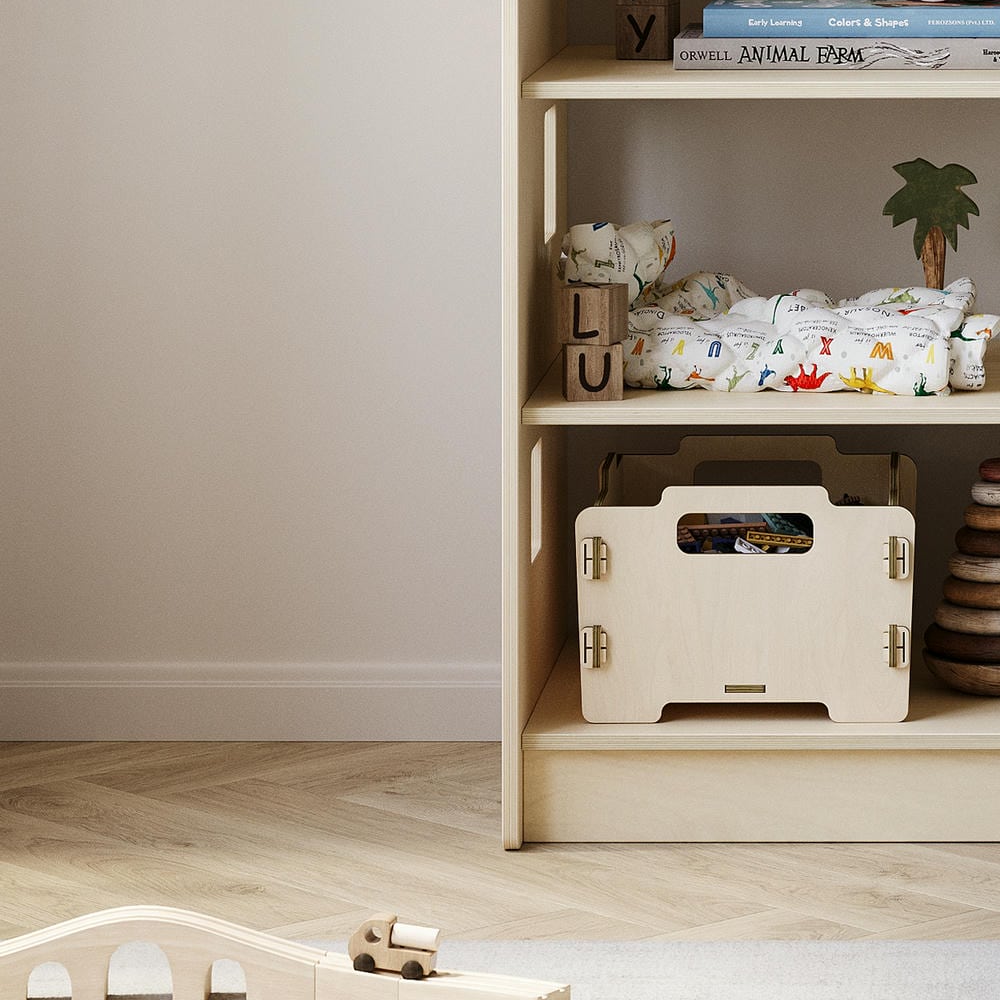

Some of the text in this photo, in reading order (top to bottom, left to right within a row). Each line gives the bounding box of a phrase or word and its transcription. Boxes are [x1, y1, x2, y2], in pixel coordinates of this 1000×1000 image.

[748, 18, 803, 28] Early Learning
[828, 18, 909, 29] Colors & Shapes
[626, 14, 656, 53] Y
[679, 44, 865, 65] ORWELL ANIMAL FARM
[573, 293, 600, 339] L
[707, 340, 722, 358] U
[772, 338, 784, 355] Y
[819, 336, 834, 356] X
[869, 341, 894, 361] W
[578, 352, 611, 393] U
